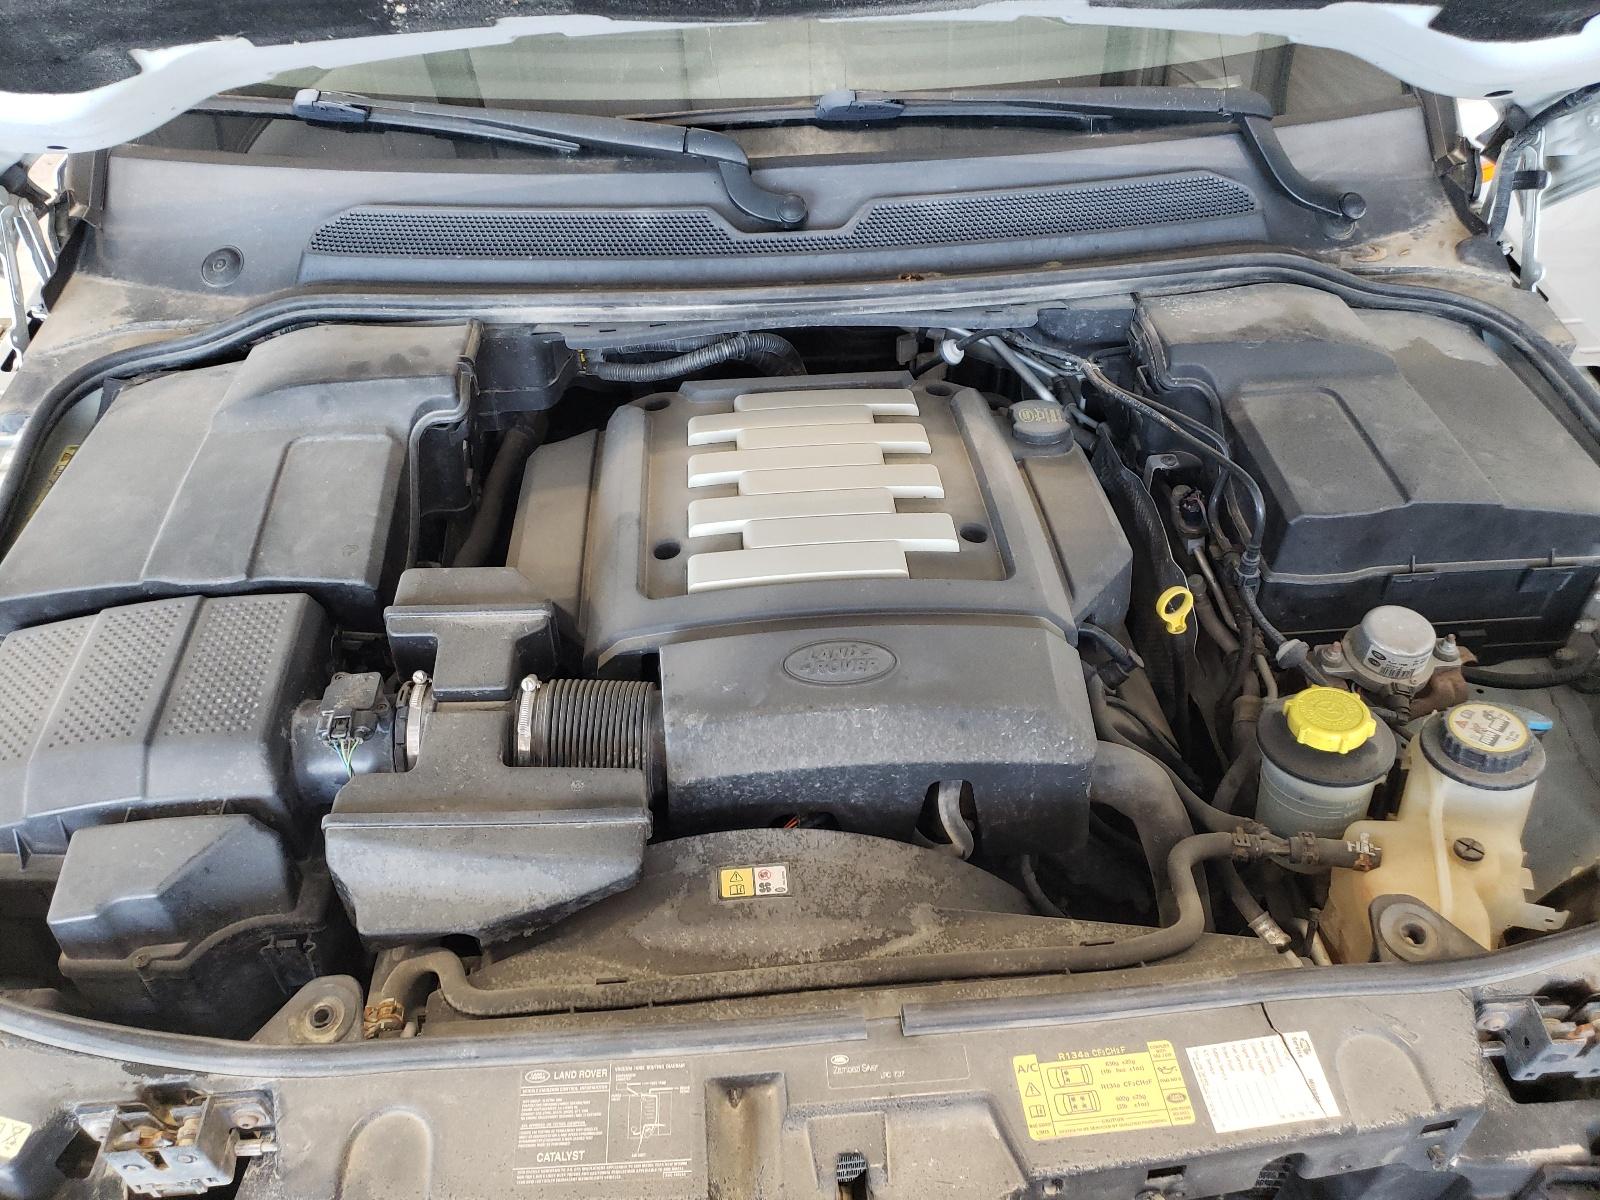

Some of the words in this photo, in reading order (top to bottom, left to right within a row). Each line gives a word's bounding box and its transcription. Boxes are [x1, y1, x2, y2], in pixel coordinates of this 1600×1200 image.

[1057, 1051, 1090, 1061] R134a
[1018, 1063, 1039, 1074] A/C
[553, 1071, 577, 1080] LAND
[579, 1069, 608, 1078] ROVER
[536, 1150, 586, 1163] CATALYST
